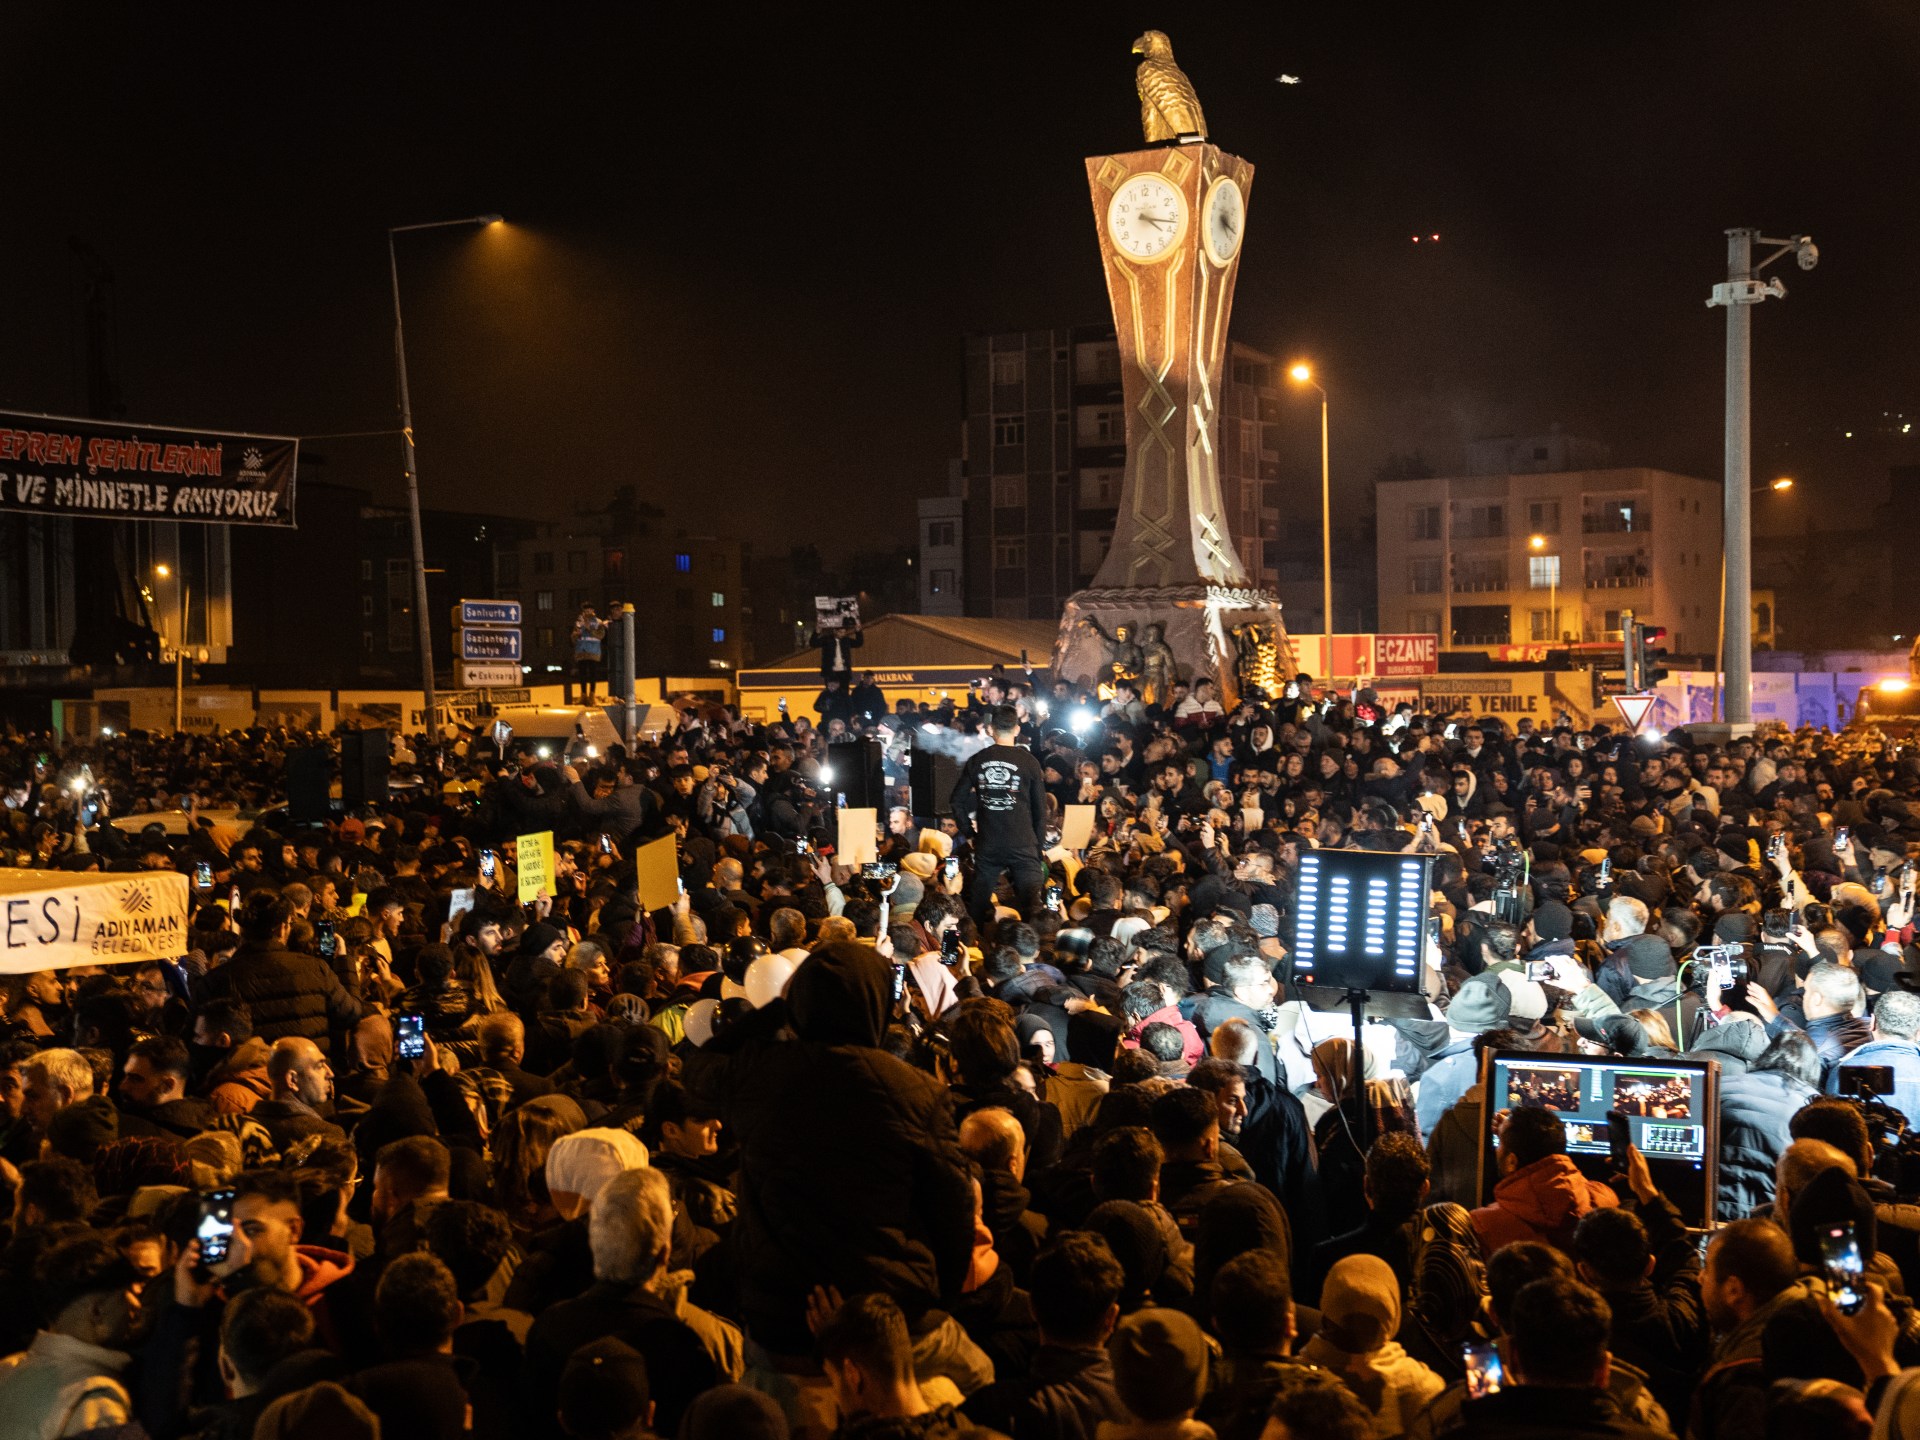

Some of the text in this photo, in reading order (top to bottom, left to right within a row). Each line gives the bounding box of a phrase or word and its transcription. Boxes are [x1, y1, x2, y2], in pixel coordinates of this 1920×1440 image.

[0, 428, 223, 477] EPREM ŞEHİTLERİNİ
[15, 473, 47, 504] VE
[54, 472, 168, 512] MİNNETLE
[173, 486, 279, 519] ANIYORUZ
[466, 633, 509, 645] Gaziantep
[466, 645, 500, 656] Malatya
[1376, 639, 1435, 663] ECZANE
[95, 915, 179, 939] ADIYAMAN
[91, 932, 181, 956] BELEDYES
